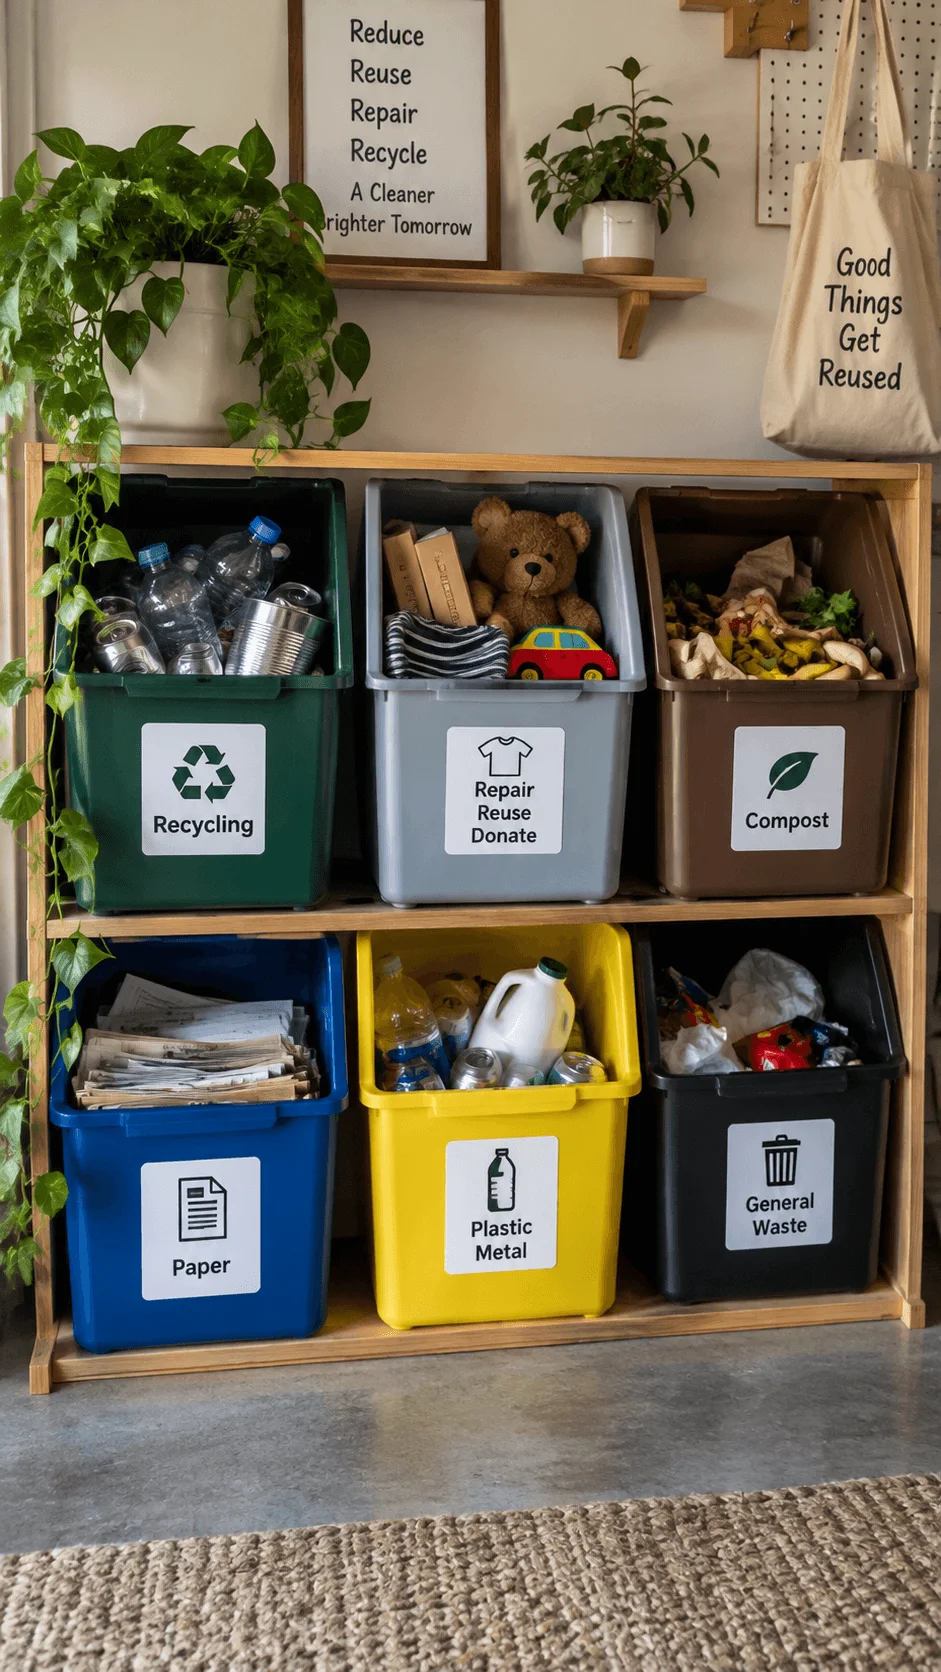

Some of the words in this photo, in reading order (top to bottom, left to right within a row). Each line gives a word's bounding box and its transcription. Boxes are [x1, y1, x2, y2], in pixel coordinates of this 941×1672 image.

[351, 19, 424, 46] Reduce
[351, 59, 411, 85] Reuse
[351, 98, 418, 130] Repair
[351, 138, 427, 170] Recycle
[351, 182, 363, 202] A
[370, 183, 435, 203] Cleaner
[326, 213, 386, 237] righter
[391, 214, 472, 235] Tomorrow
[837, 247, 891, 277] Good
[824, 285, 902, 324] Things
[839, 323, 881, 353] Get
[819, 359, 902, 390] Reused
[475, 782, 535, 802] Repair
[478, 804, 531, 820] Reuse
[746, 812, 829, 833] Compost
[153, 815, 254, 838] Recycling
[471, 828, 537, 843] Donate
[746, 1192, 814, 1212] General
[472, 1219, 532, 1237] Plastic
[753, 1218, 807, 1236] Waste
[476, 1242, 526, 1261] Metal
[172, 1259, 231, 1279] Paper
